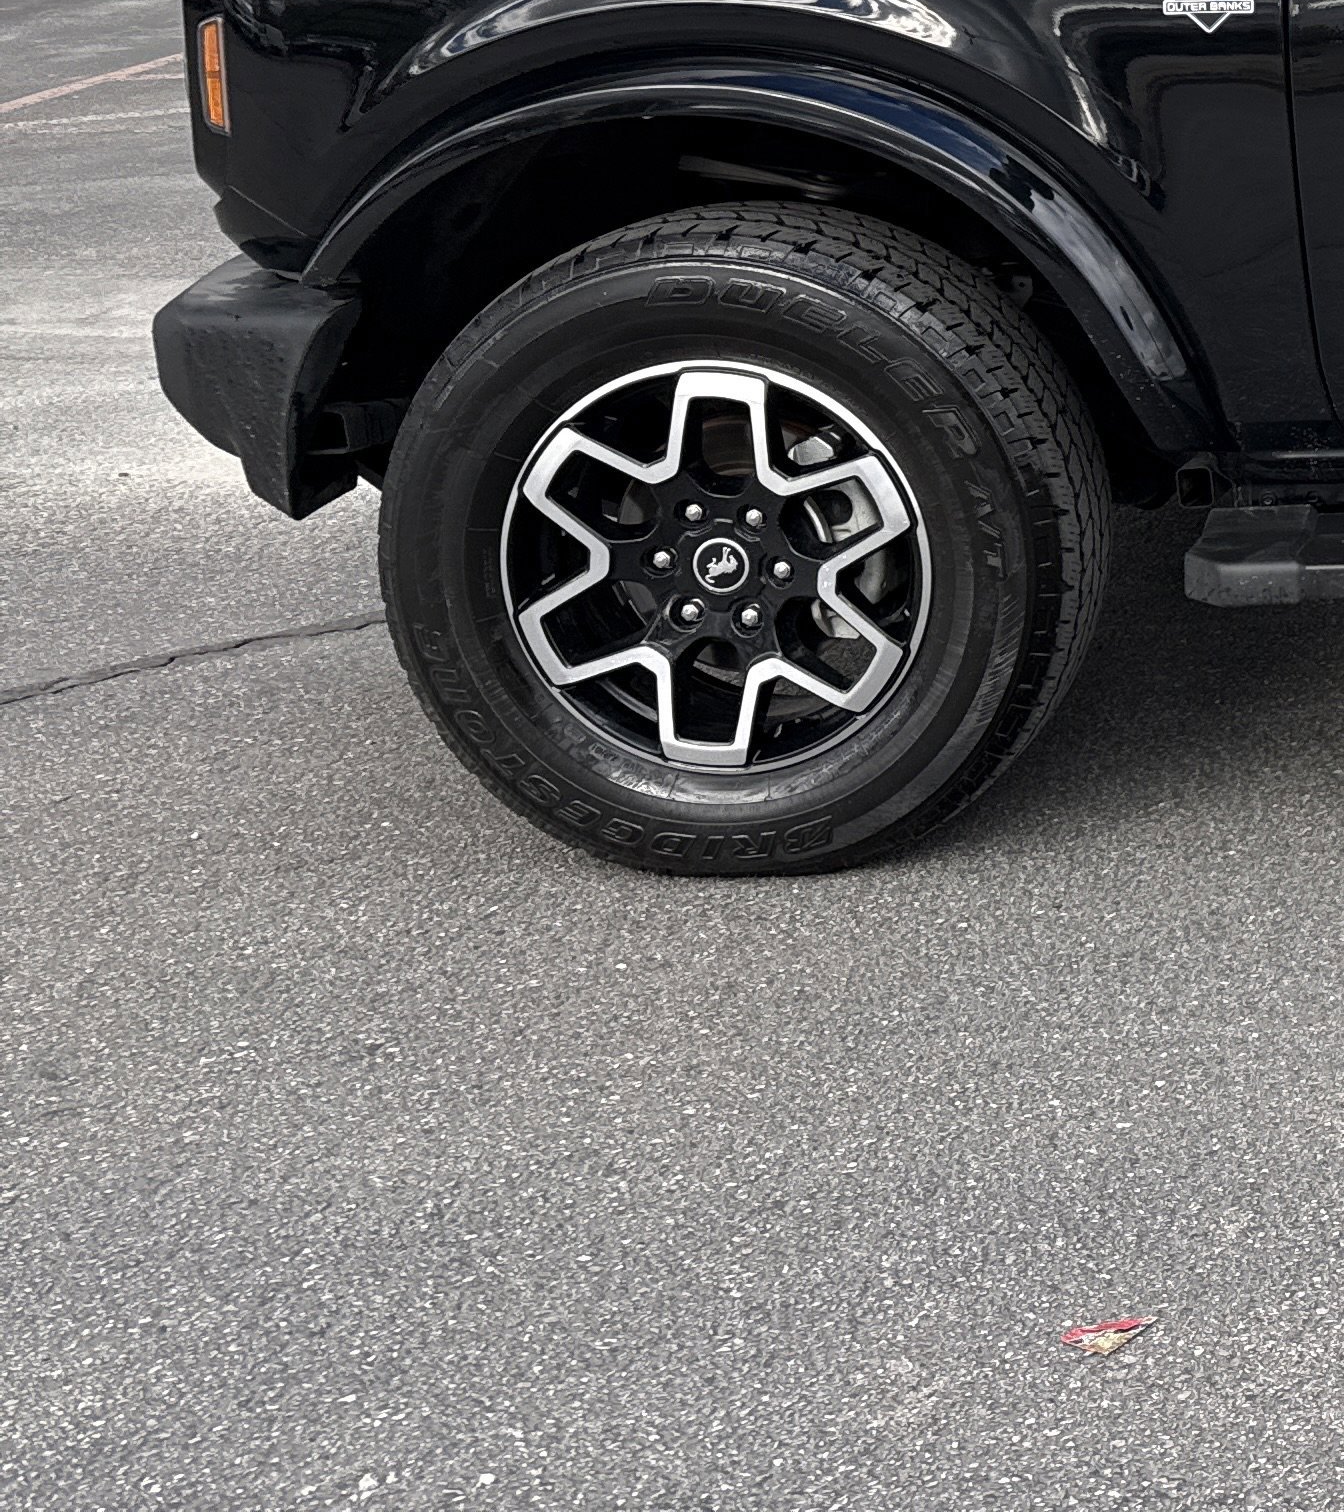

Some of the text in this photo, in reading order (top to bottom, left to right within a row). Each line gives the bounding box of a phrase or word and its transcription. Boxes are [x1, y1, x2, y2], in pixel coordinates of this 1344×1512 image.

[1166, 1, 1251, 12] OUTER BANKS
[644, 275, 981, 459] DUELER
[412, 623, 836, 860] BRIDGESTONE
